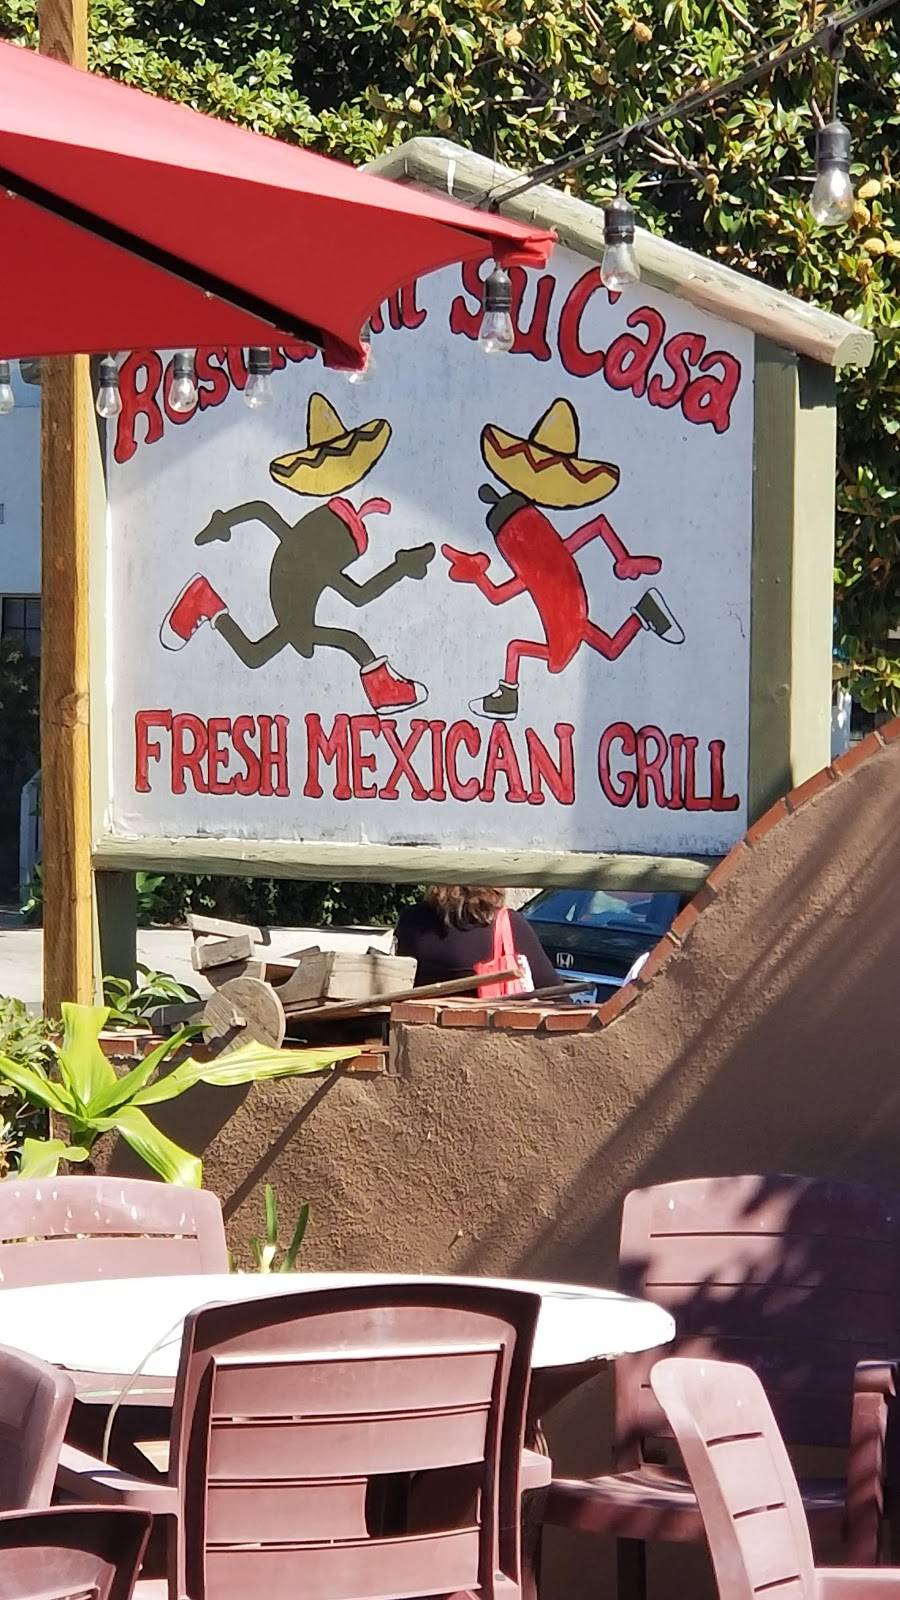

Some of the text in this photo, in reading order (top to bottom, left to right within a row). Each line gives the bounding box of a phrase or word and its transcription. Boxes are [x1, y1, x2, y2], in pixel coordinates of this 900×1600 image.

[134, 708, 740, 811] FRESH MEXICAN GRILL
